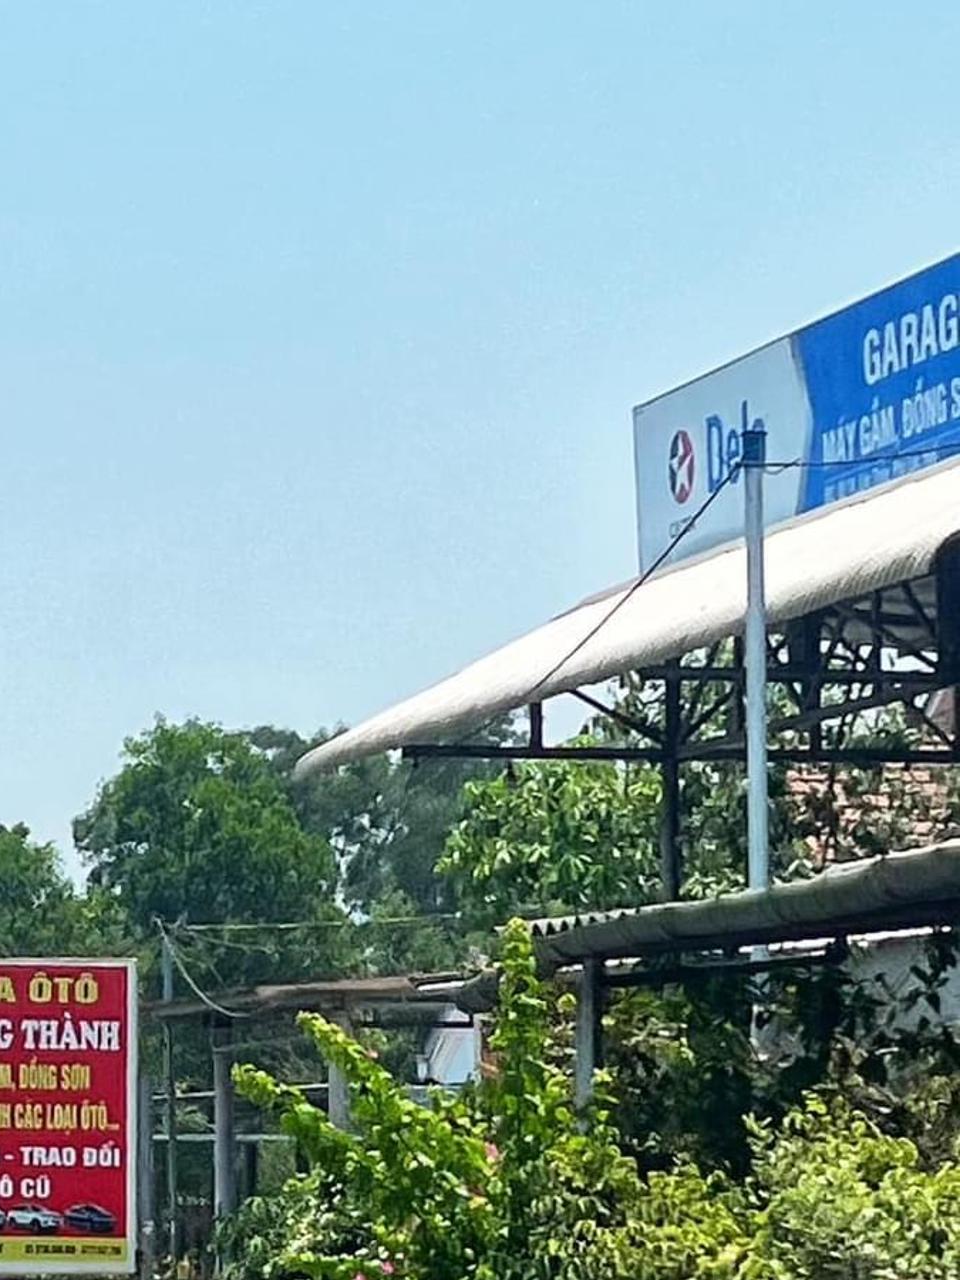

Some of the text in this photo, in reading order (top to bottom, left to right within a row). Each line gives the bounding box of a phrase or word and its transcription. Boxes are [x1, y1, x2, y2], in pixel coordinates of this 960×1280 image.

[705, 400, 764, 493] De
[29, 972, 99, 1004] ÔTÔ
[21, 1011, 120, 1050] THÀNH
[3, 1153, 15, 1161] -
[20, 1146, 76, 1167] TRAO
[20, 1174, 51, 1198] CŨ
